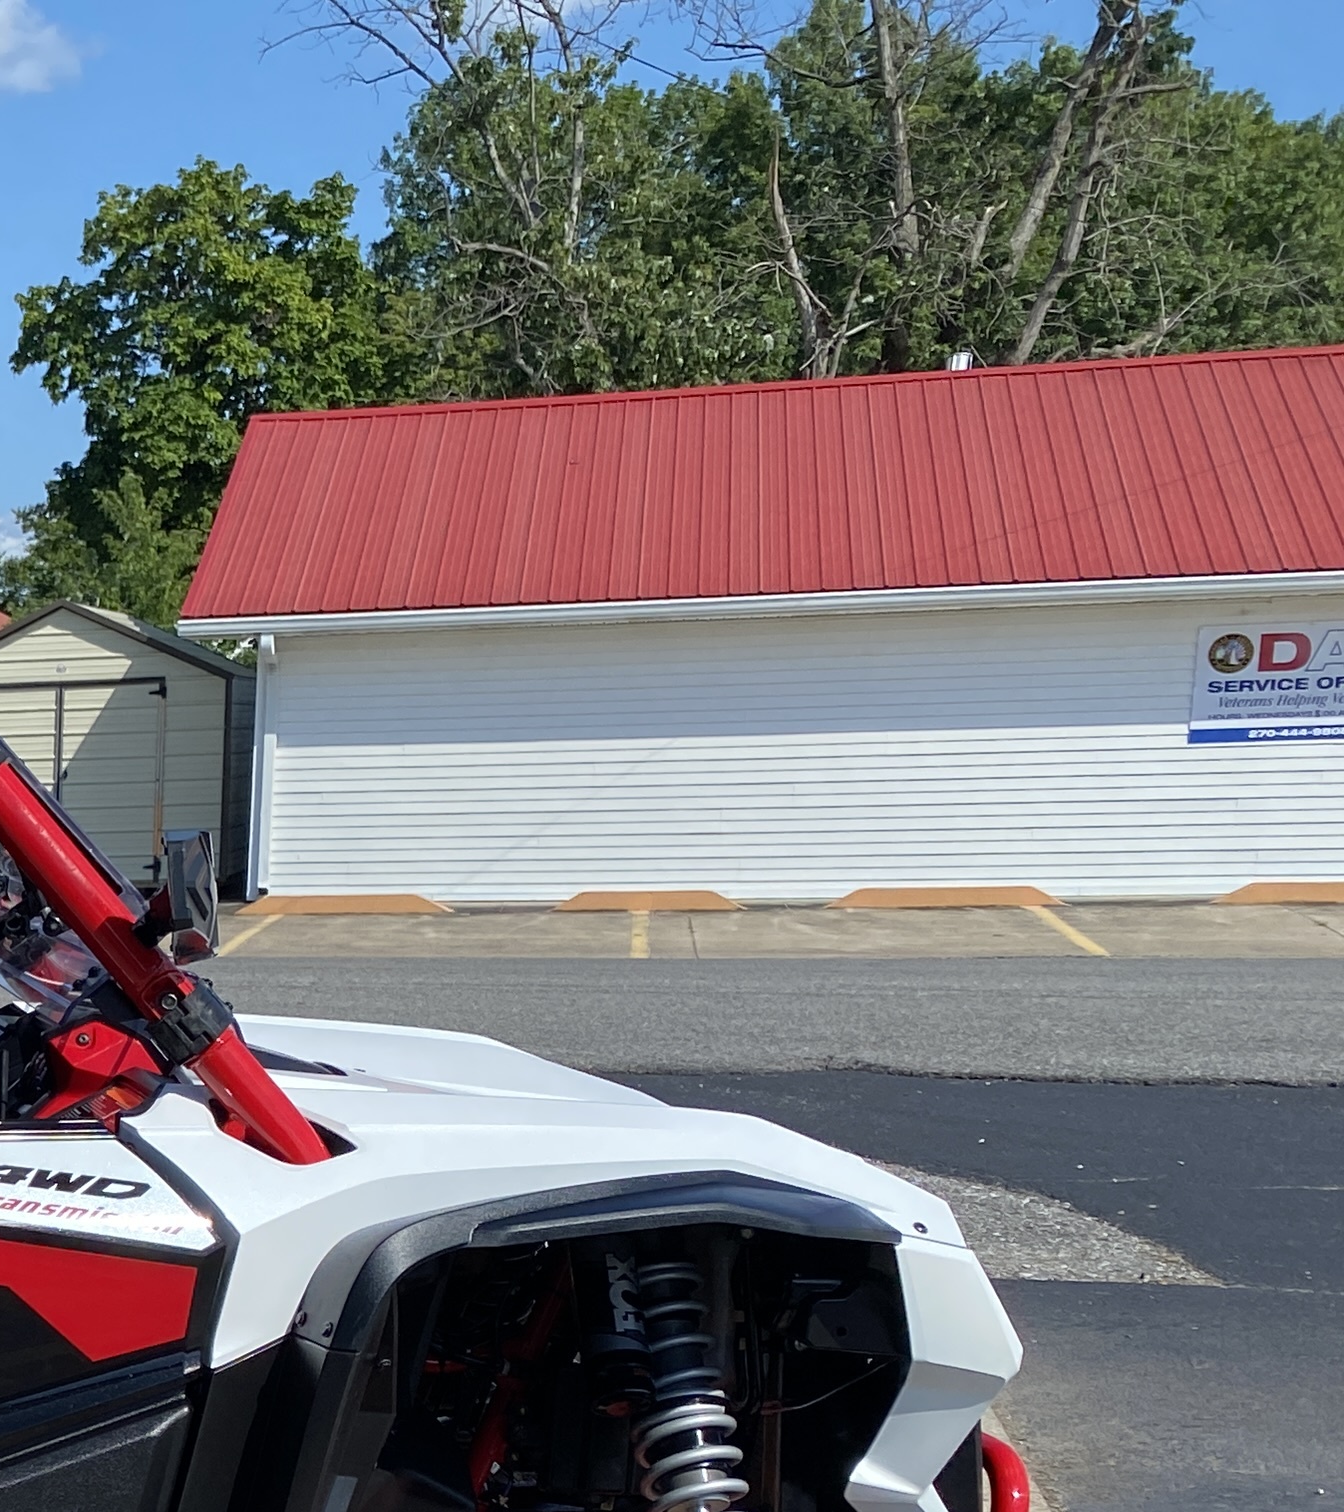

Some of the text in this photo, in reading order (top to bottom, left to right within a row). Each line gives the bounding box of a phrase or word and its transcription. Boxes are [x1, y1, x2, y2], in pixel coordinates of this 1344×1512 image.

[1207, 677, 1309, 694] SERVICE
[1218, 696, 1274, 709] Veterans
[1277, 694, 1328, 709] Helping
[604, 1252, 647, 1336] FOX
